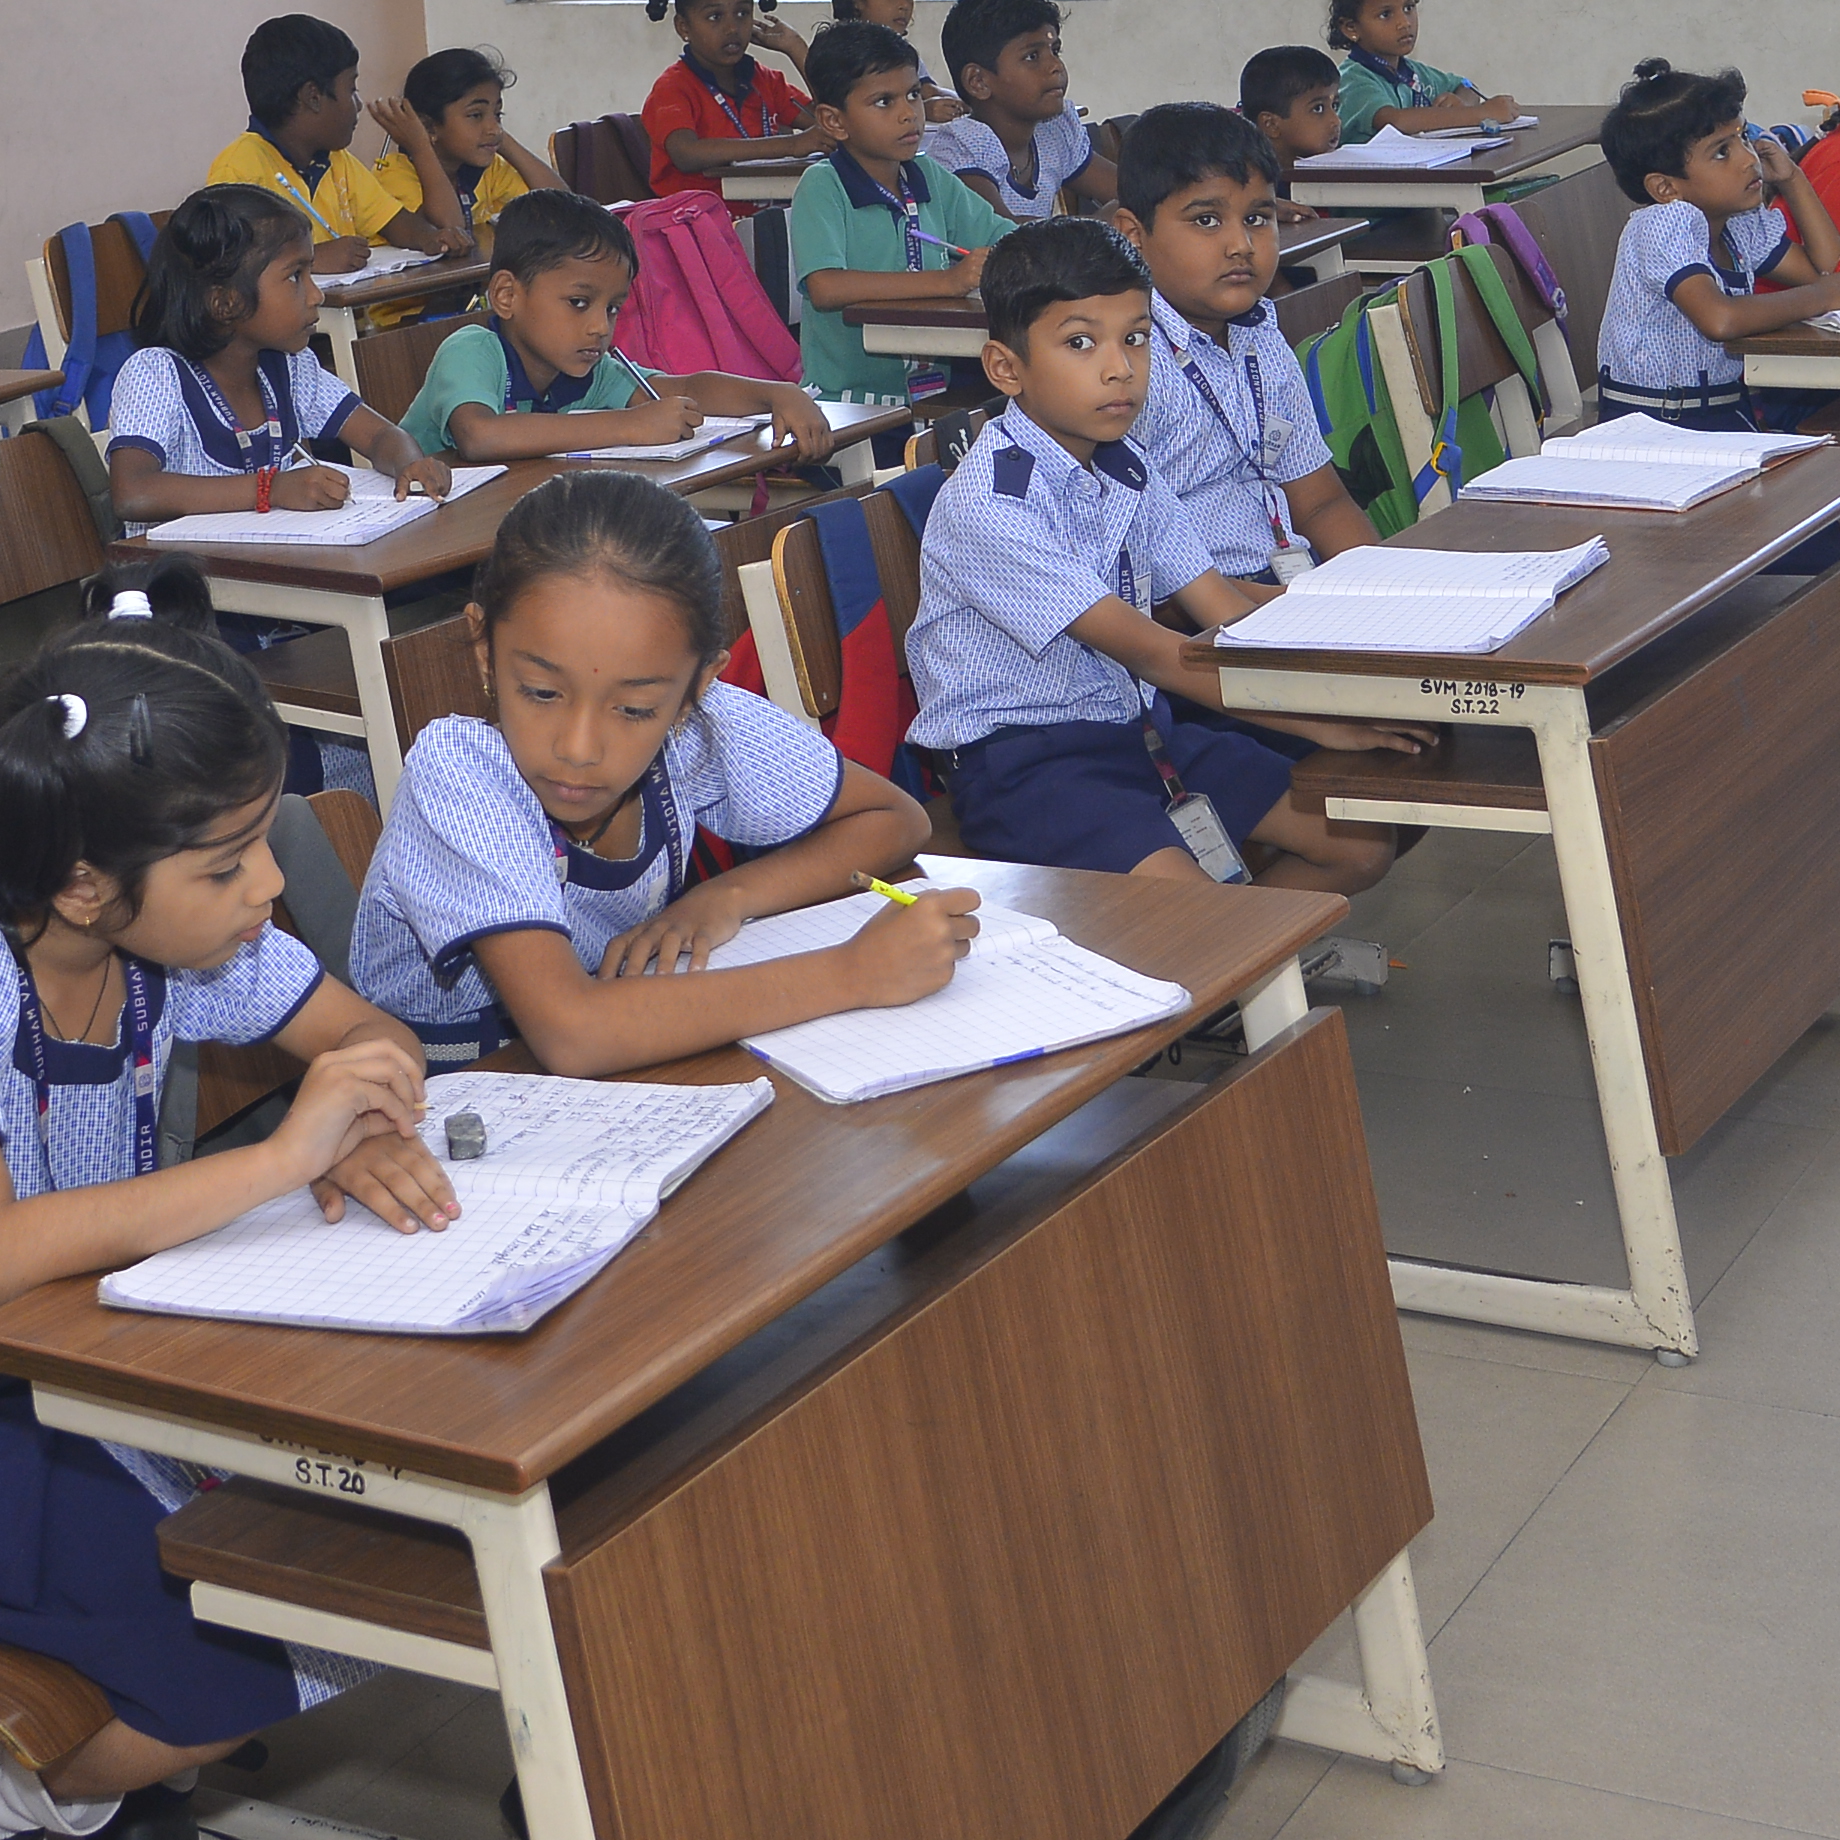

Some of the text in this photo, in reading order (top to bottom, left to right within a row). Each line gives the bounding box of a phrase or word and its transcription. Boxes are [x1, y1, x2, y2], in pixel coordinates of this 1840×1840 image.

[1192, 371, 1217, 405] MANDIR
[1250, 362, 1262, 398] MANDIR
[211, 390, 235, 421] SUBHAM
[1122, 570, 1131, 602] NDIR
[1419, 678, 1525, 700] SVM 2018-19
[1450, 699, 1500, 714] S.T.22
[660, 789, 682, 894] SUBHAM VIDYA
[26, 1008, 46, 1081] SUBHAM
[140, 1123, 154, 1172] NDIR
[295, 1457, 366, 1495] S.T.20
